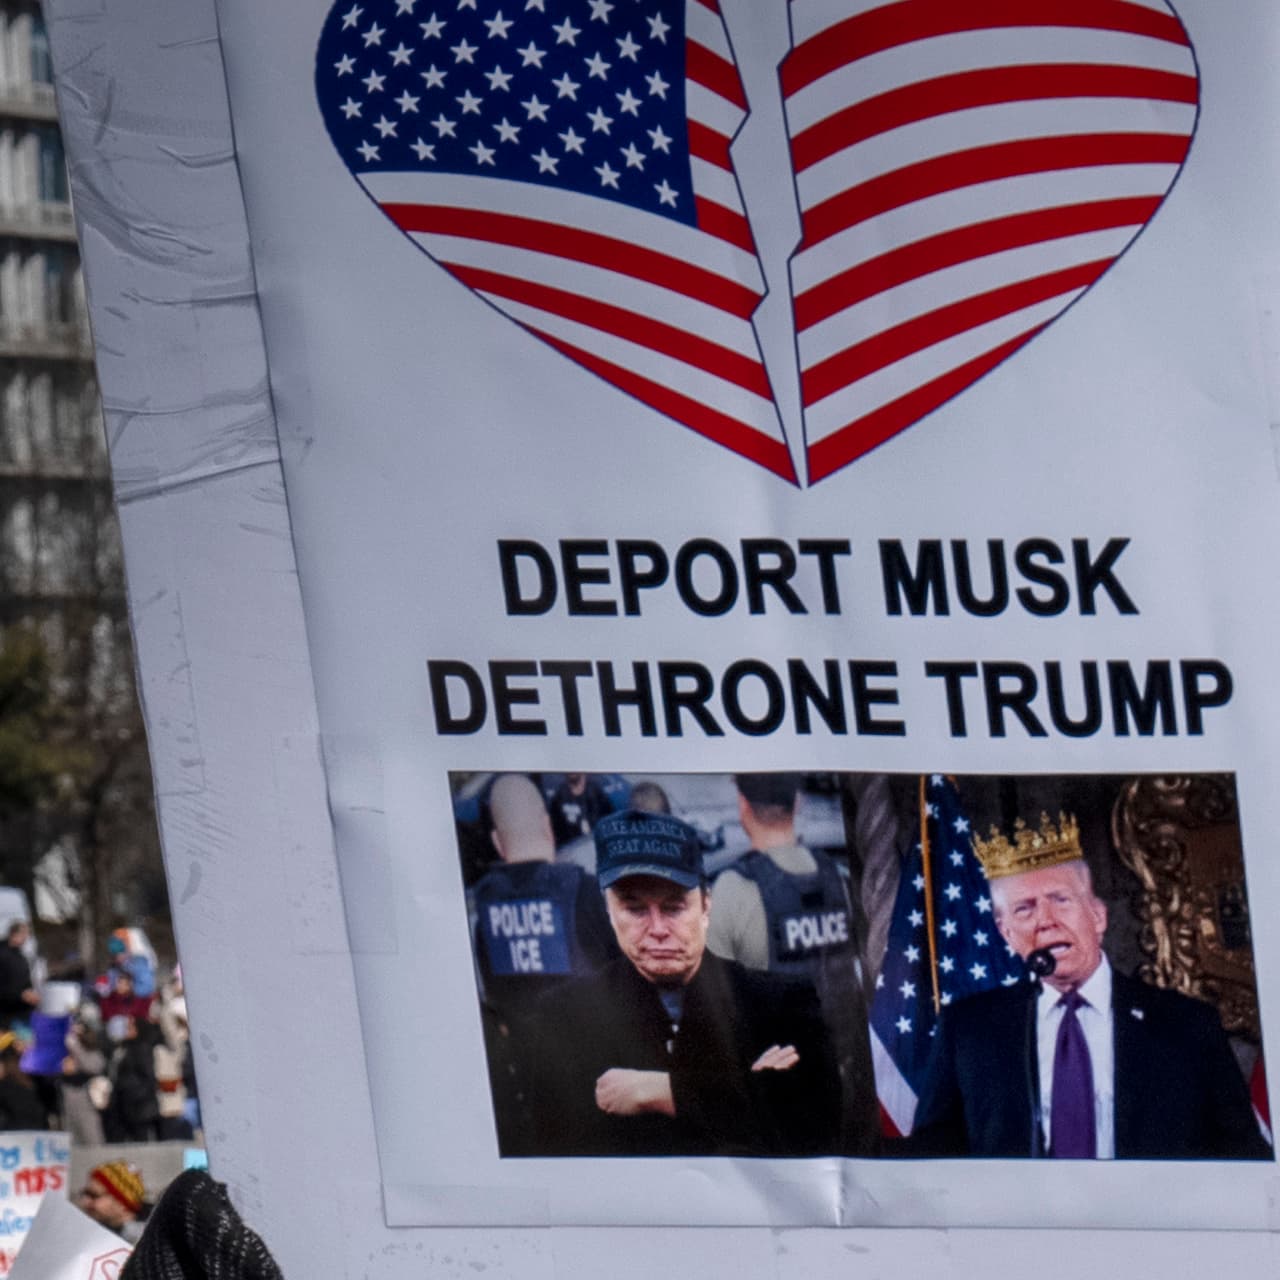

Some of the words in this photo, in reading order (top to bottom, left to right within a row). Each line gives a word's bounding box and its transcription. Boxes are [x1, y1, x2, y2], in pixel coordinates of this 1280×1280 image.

[496, 537, 850, 617] DEPORT
[878, 537, 1140, 616] MUSK
[427, 659, 906, 737] DETHRONE
[924, 659, 1234, 738] TRUMP
[489, 901, 555, 937] POLICE
[785, 911, 849, 951] POLICE
[509, 938, 545, 973] ICE
